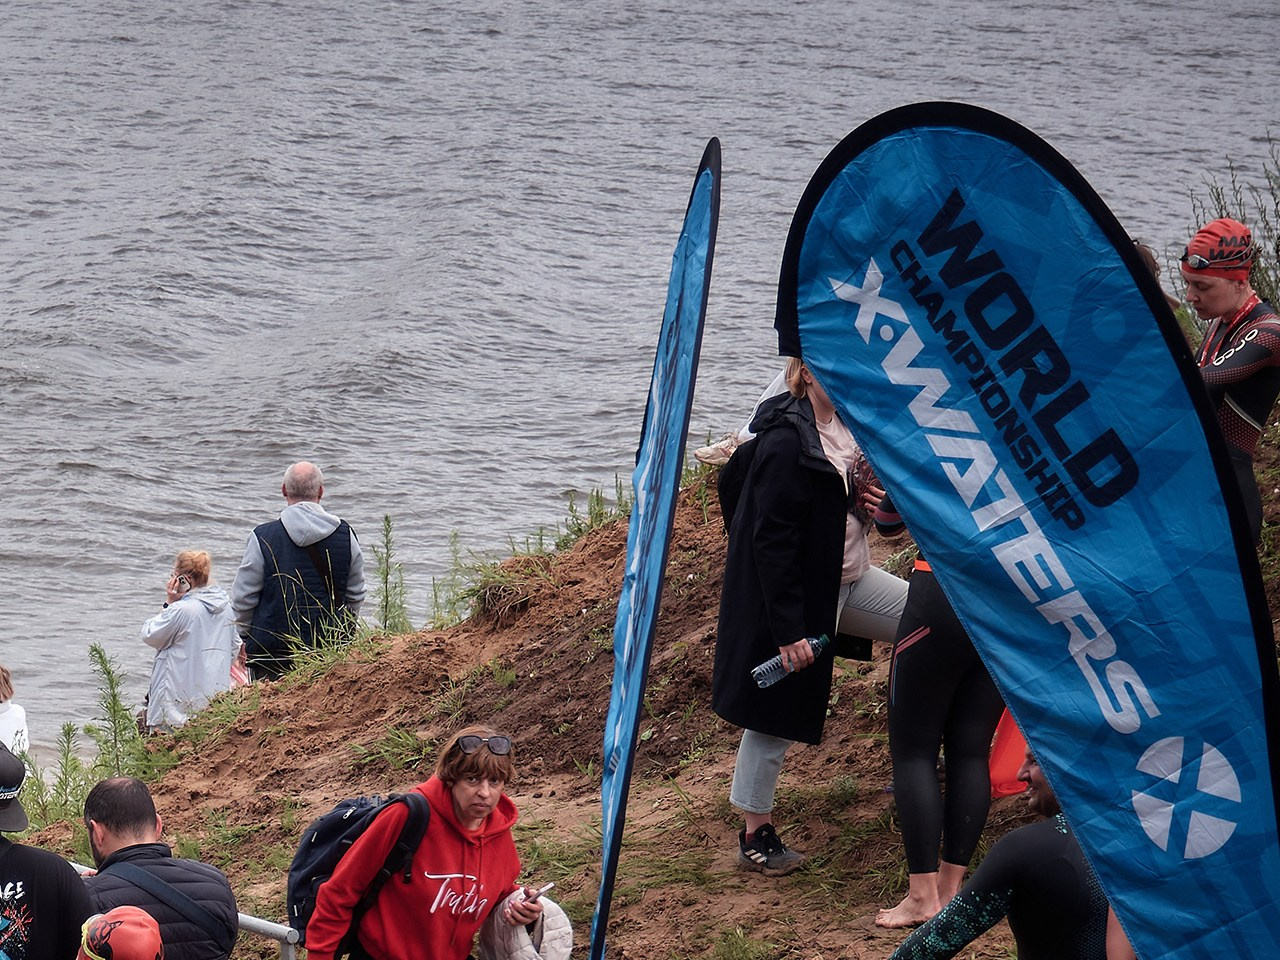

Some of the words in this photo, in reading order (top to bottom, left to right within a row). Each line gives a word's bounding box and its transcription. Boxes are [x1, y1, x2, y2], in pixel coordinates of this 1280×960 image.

[889, 240, 1086, 532] CHAMPIONSHIP
[917, 187, 1140, 509] WORLD
[1212, 329, 1258, 366] orca
